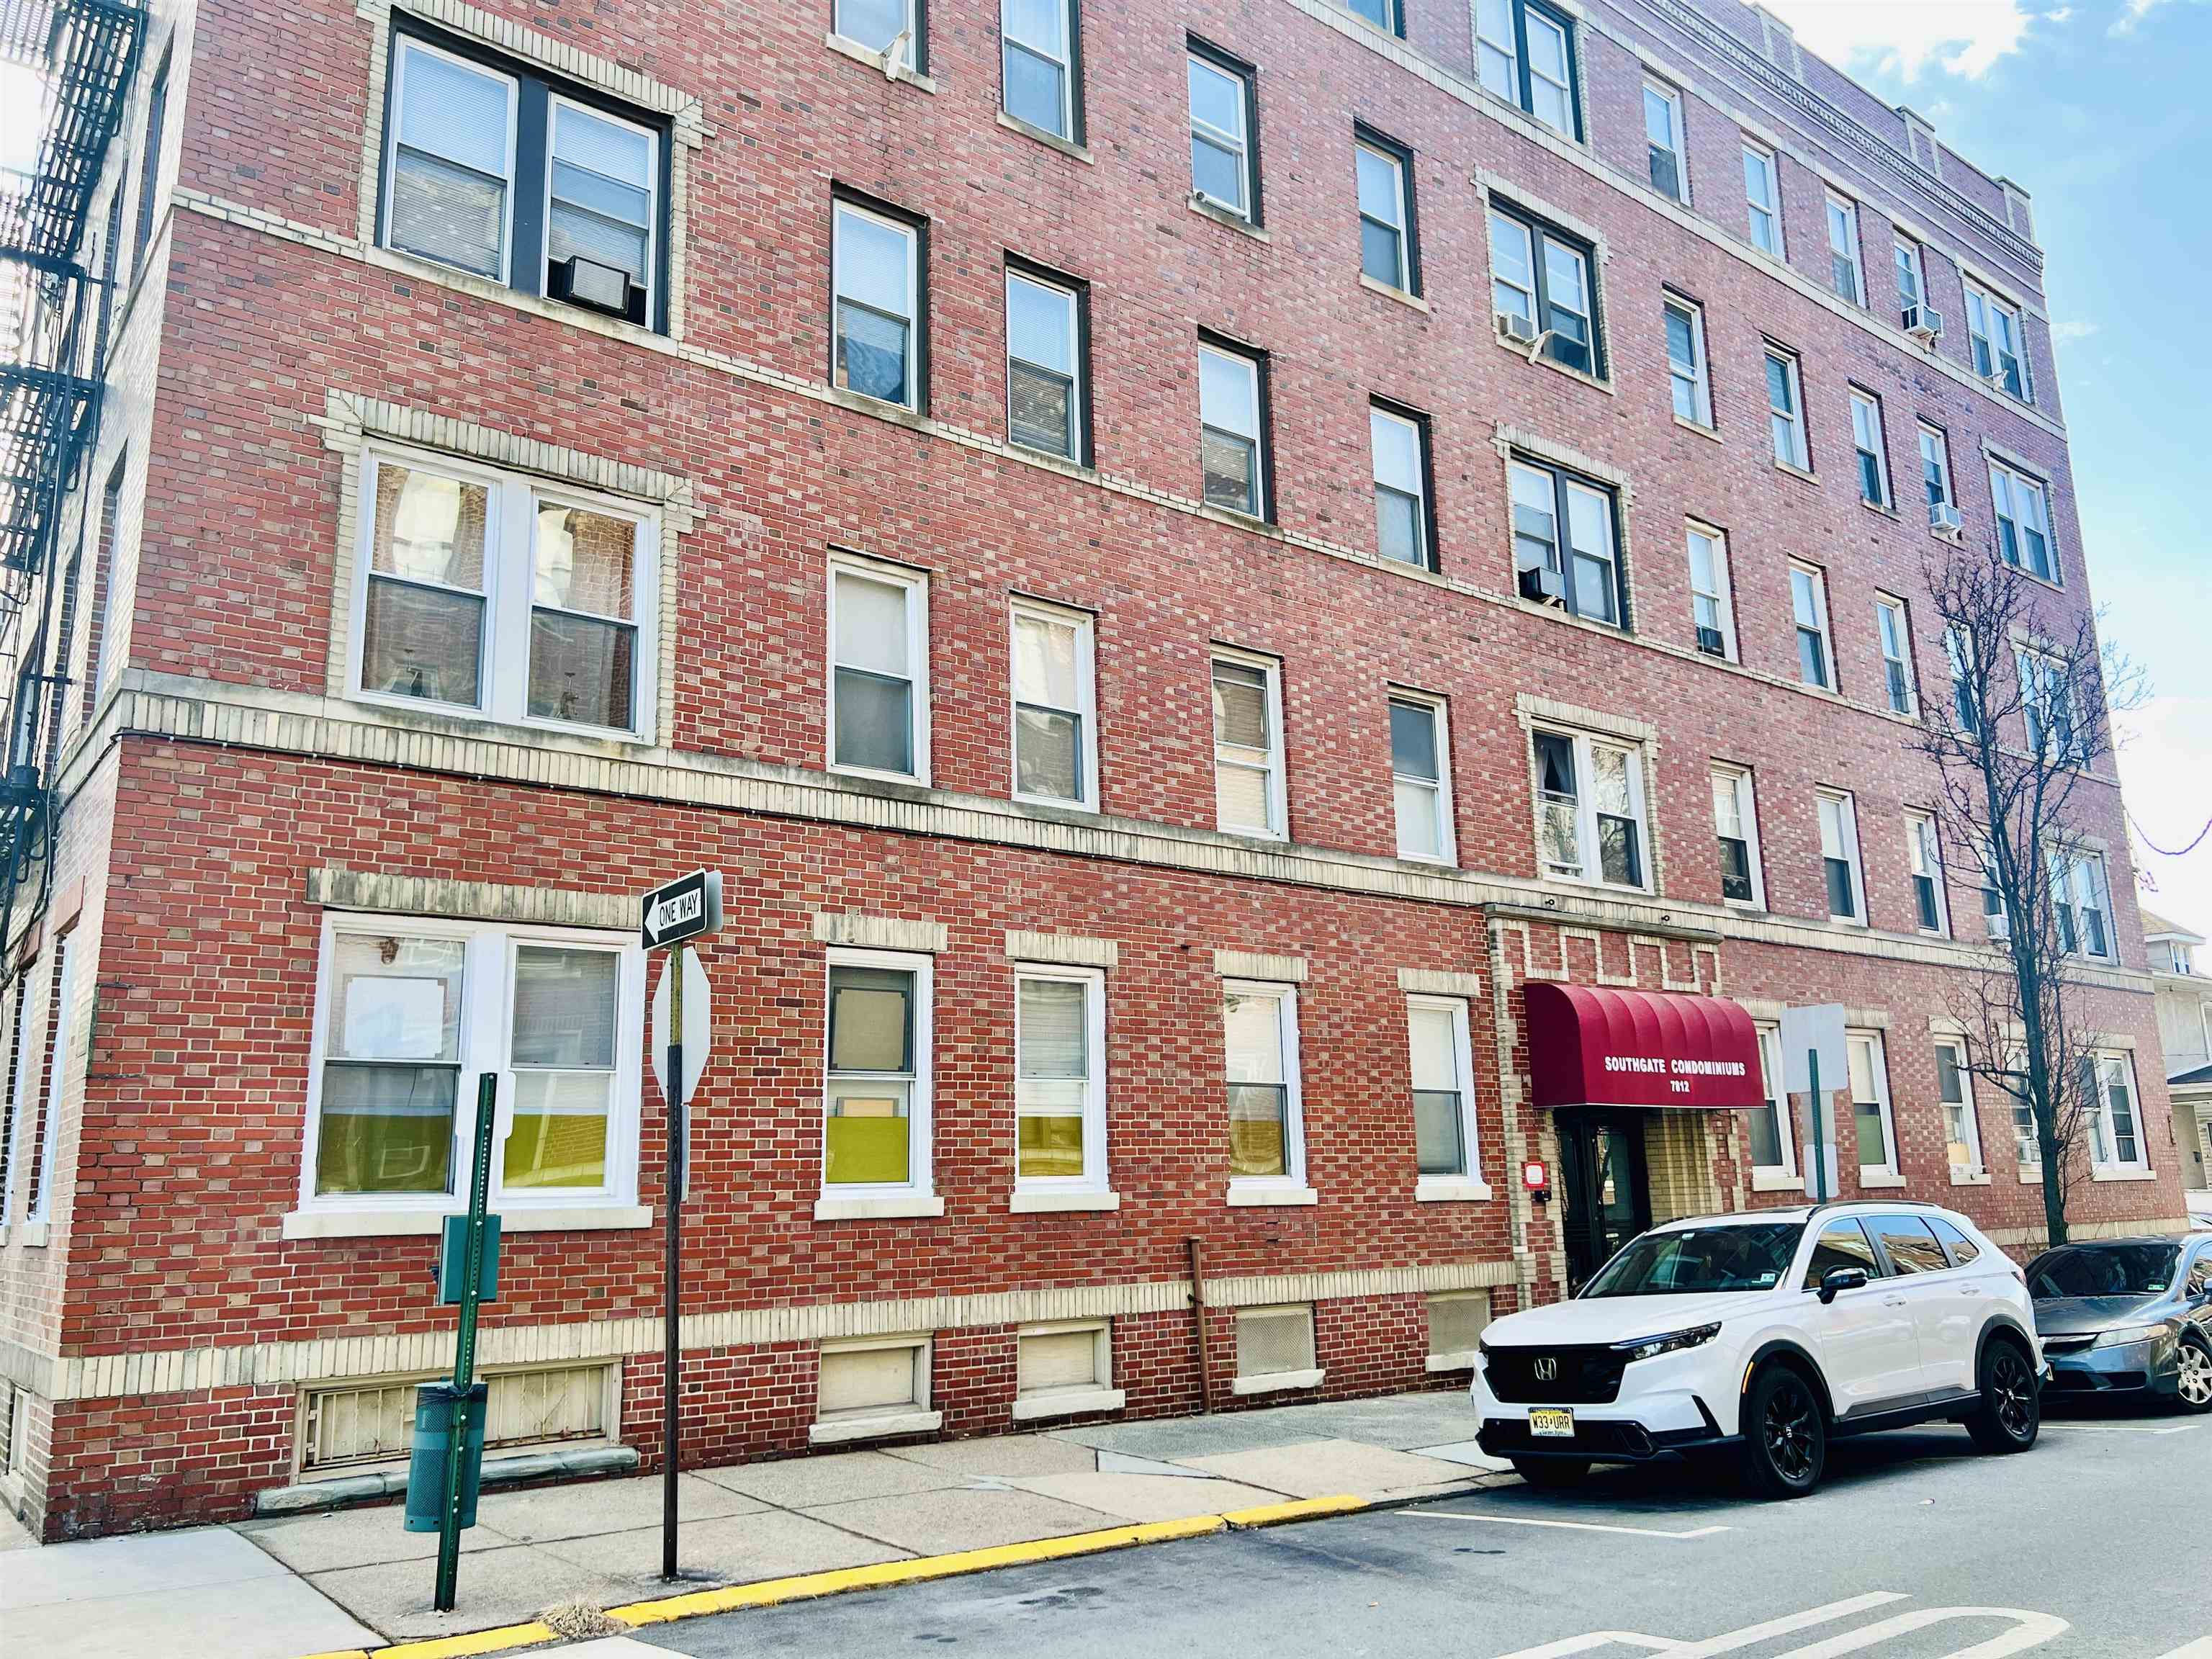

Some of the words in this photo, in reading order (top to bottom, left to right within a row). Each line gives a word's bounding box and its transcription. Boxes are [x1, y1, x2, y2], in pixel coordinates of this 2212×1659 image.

[660, 901, 676, 927] ONE
[680, 892, 698, 919] WAY
[1604, 1056, 1666, 1073] SOUTHGATE
[1671, 1059, 1746, 1076] CONDOMINIUMS
[1671, 1080, 1690, 1092] 7812
